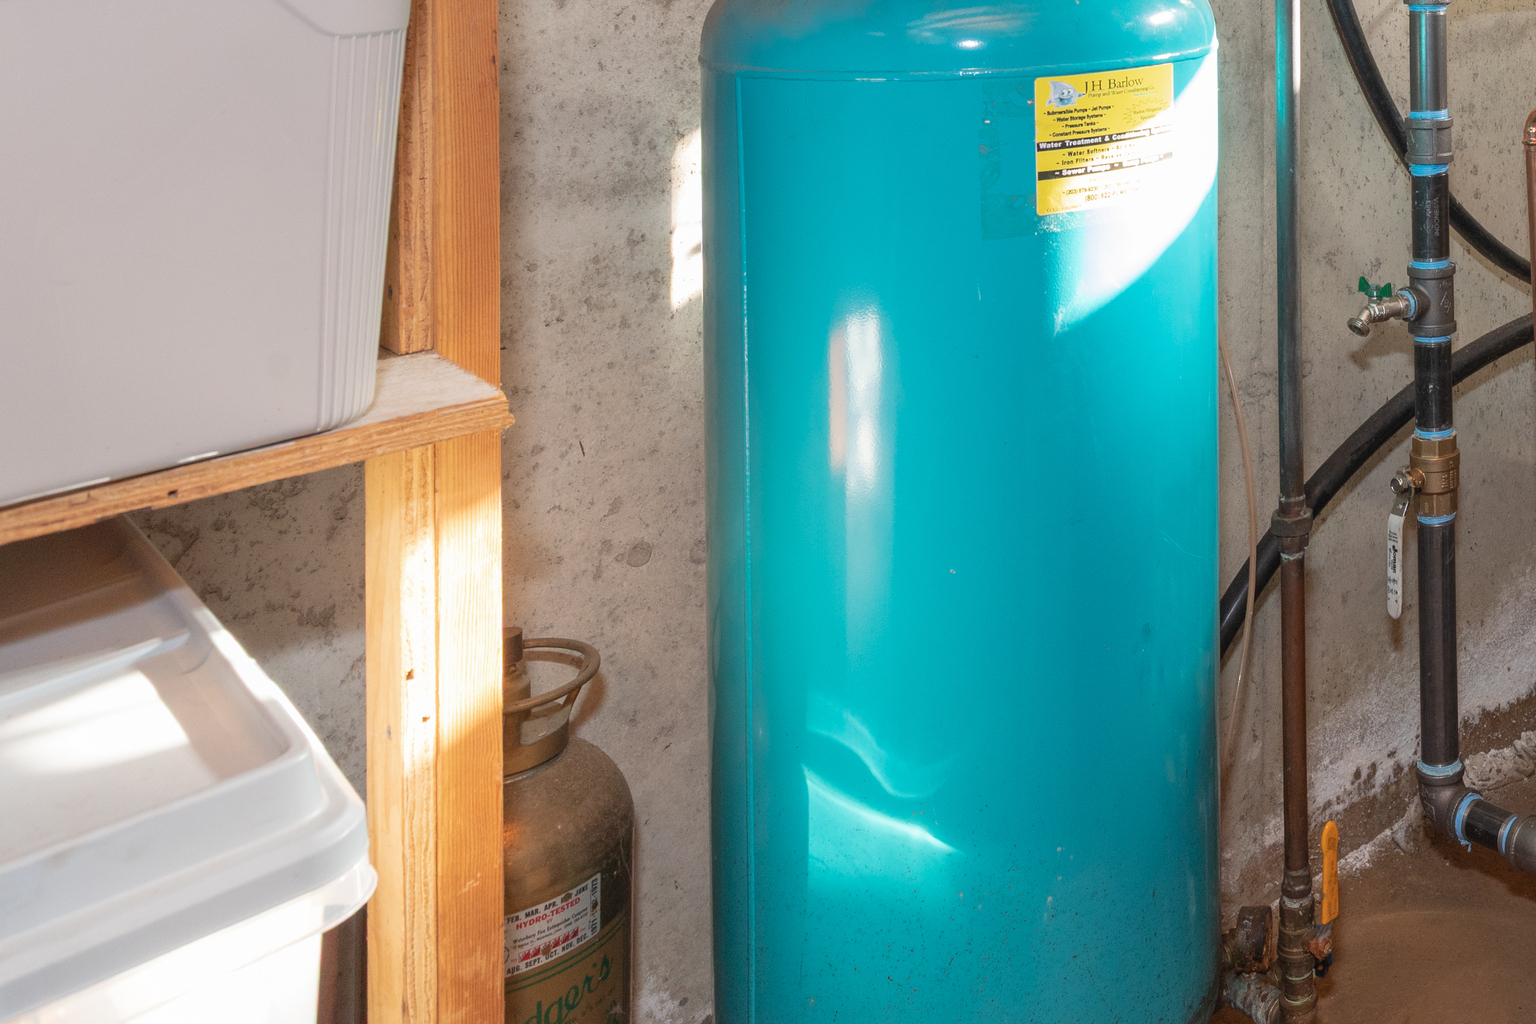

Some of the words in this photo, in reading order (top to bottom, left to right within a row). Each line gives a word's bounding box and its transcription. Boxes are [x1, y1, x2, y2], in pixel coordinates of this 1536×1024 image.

[1108, 77, 1144, 91] Barlow
[1065, 136, 1102, 147] Treatment
[1068, 148, 1085, 157] Water
[574, 884, 589, 896] JUNE
[507, 916, 521, 924] FEB.
[525, 908, 541, 918] MAR.
[544, 901, 558, 911] APR.
[516, 897, 580, 930] HYDRO-TESTED
[538, 927, 546, 936] Fire
[507, 965, 522, 975] AUG.
[525, 958, 542, 969] SEPT.
[545, 950, 559, 961] OCT.
[562, 942, 574, 953] NOV.
[576, 933, 588, 945] DEC.
